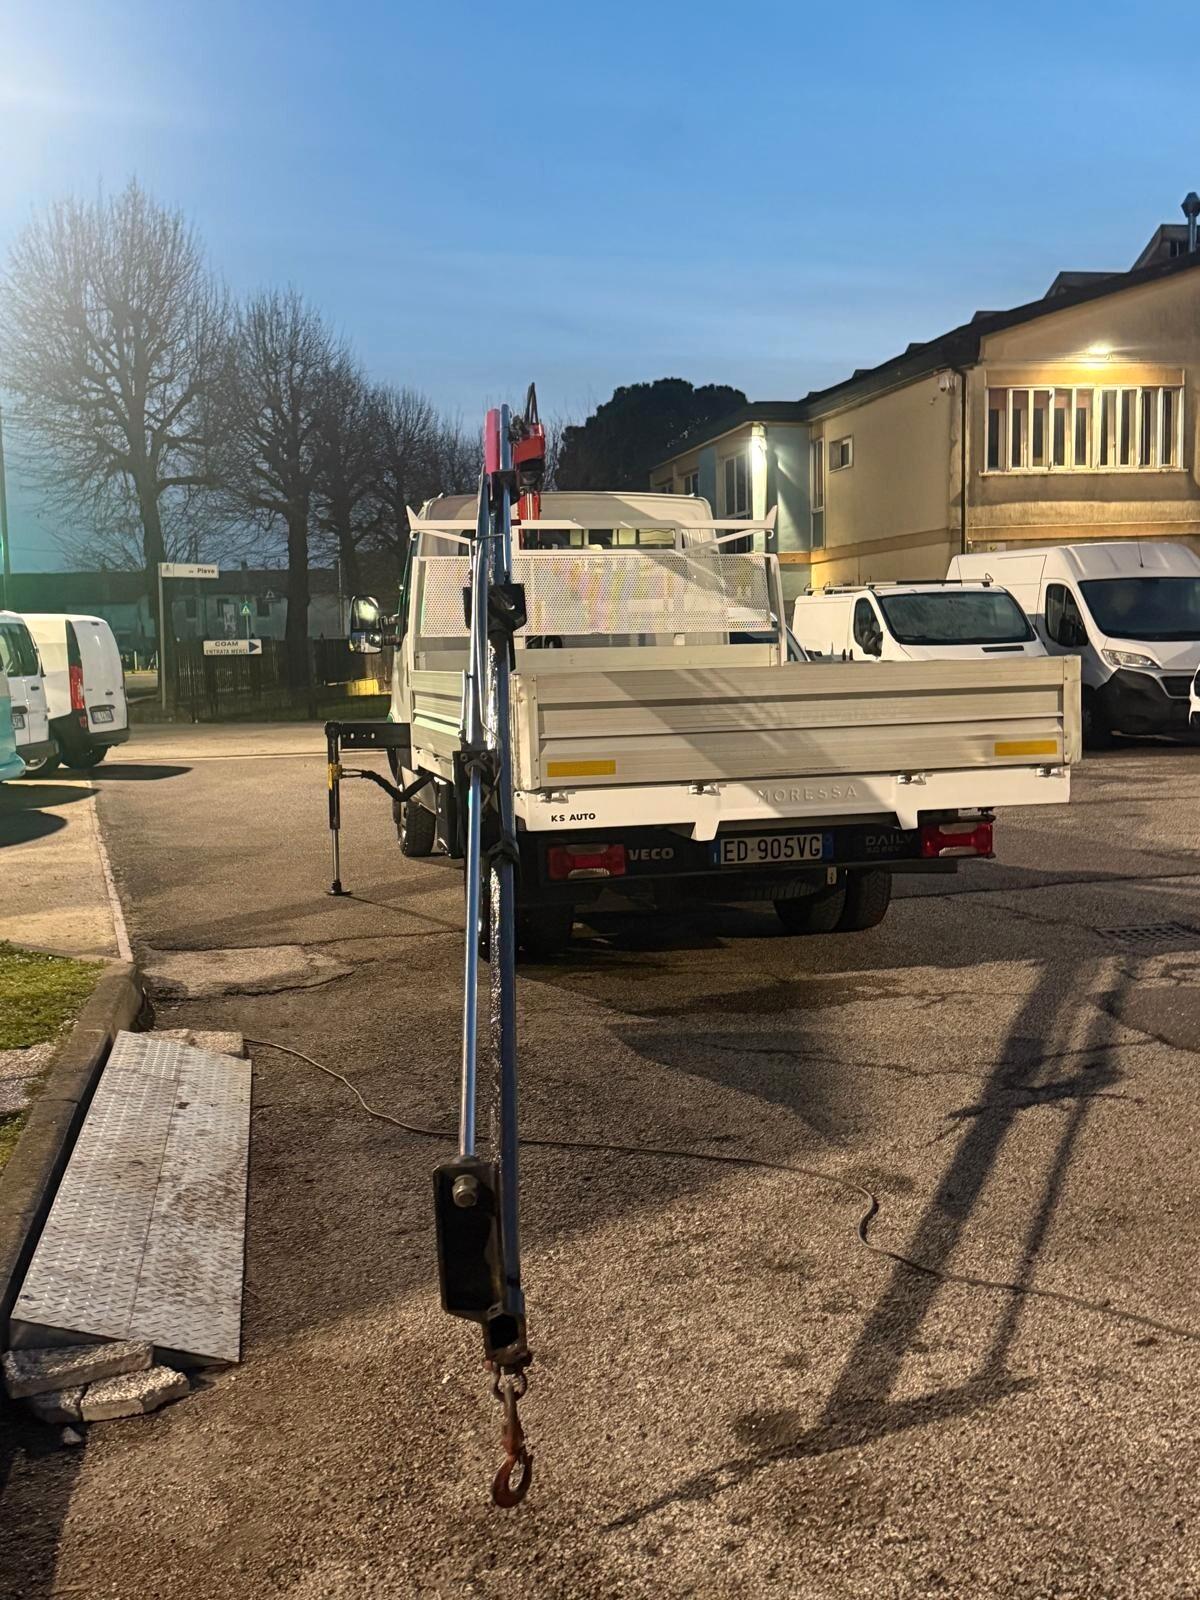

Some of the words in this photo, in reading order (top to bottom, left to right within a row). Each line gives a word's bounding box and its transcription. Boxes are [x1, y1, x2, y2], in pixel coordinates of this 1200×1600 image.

[758, 783, 857, 803] MORESSA
[569, 812, 596, 821] AUTO
[628, 847, 675, 860] VECO
